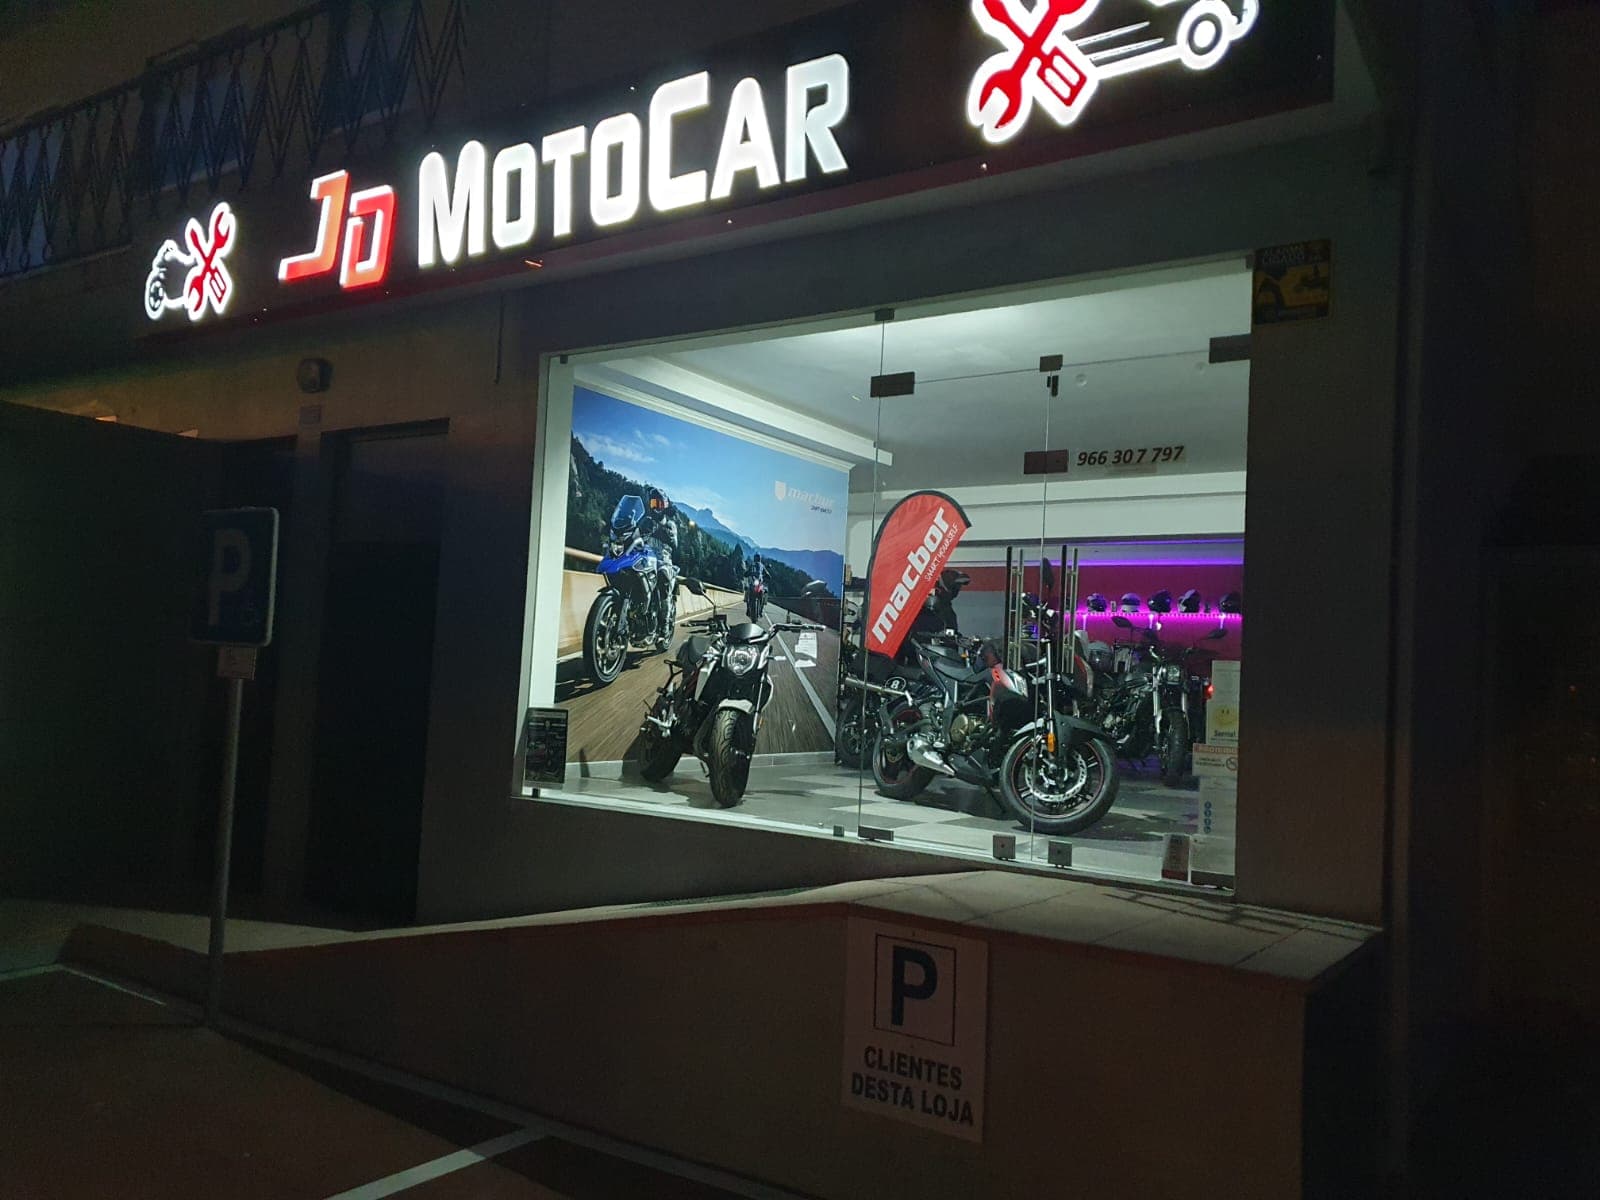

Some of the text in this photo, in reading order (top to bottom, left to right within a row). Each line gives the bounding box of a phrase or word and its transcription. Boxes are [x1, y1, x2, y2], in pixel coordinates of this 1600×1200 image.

[278, 169, 398, 290] JD
[1077, 445, 1184, 466] 966 307 797
[208, 528, 251, 626] P
[872, 507, 949, 644] macbor
[891, 945, 938, 1026] P
[852, 1072, 974, 1126] DESTA LOJA
[865, 1045, 962, 1091] CLIENTES
